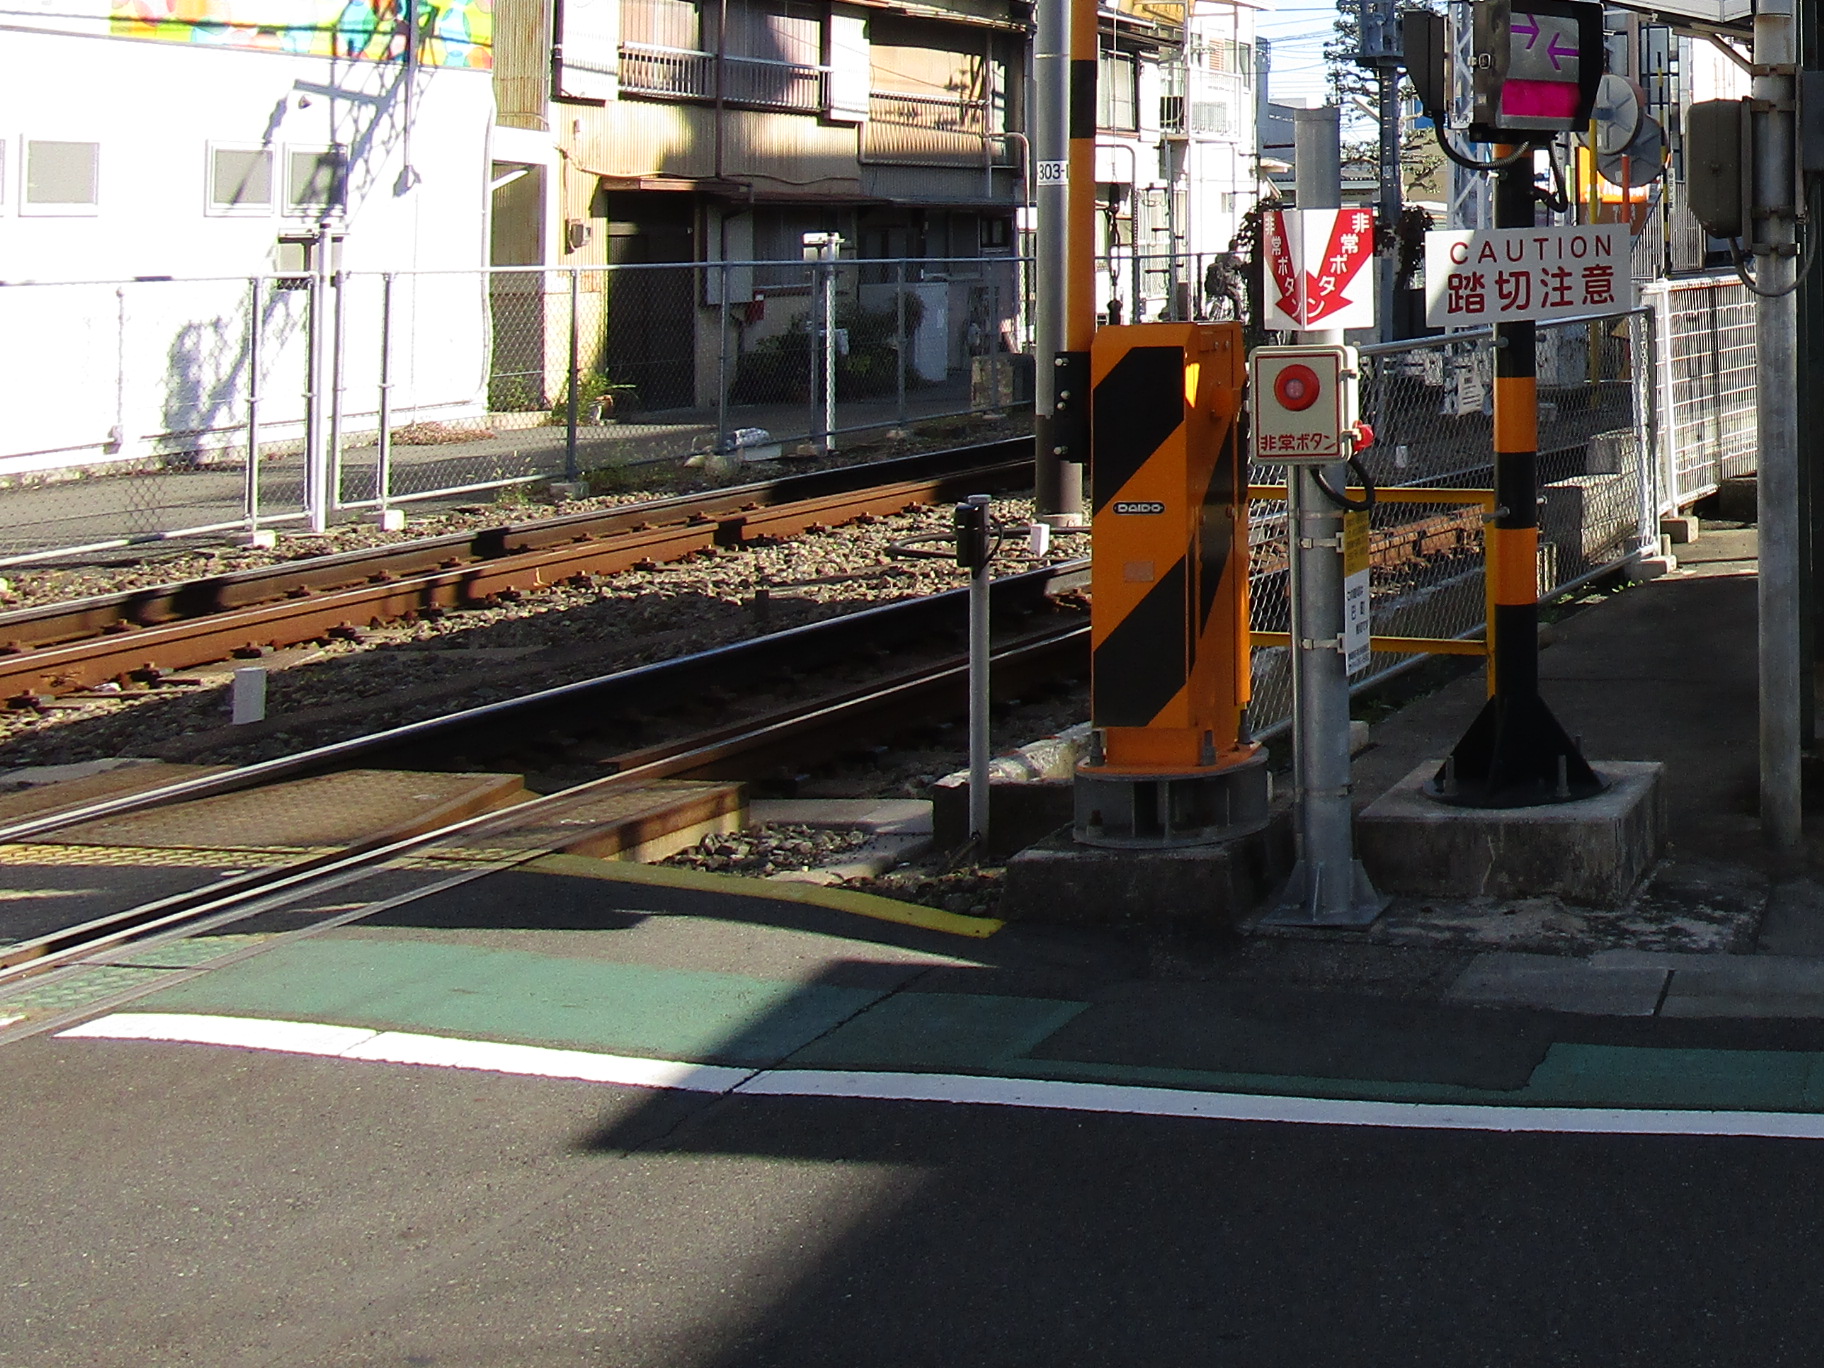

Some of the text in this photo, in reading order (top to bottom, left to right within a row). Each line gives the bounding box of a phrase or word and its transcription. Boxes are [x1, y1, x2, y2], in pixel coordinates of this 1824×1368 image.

[1264, 215, 1301, 318] 非常ボタン
[1307, 212, 1370, 318] 非常ボタン
[1450, 234, 1612, 265] CAUTION
[1447, 263, 1615, 314] 踏切注意
[1259, 433, 1336, 452] 非常ボタン
[1117, 503, 1162, 513] DAIDO
